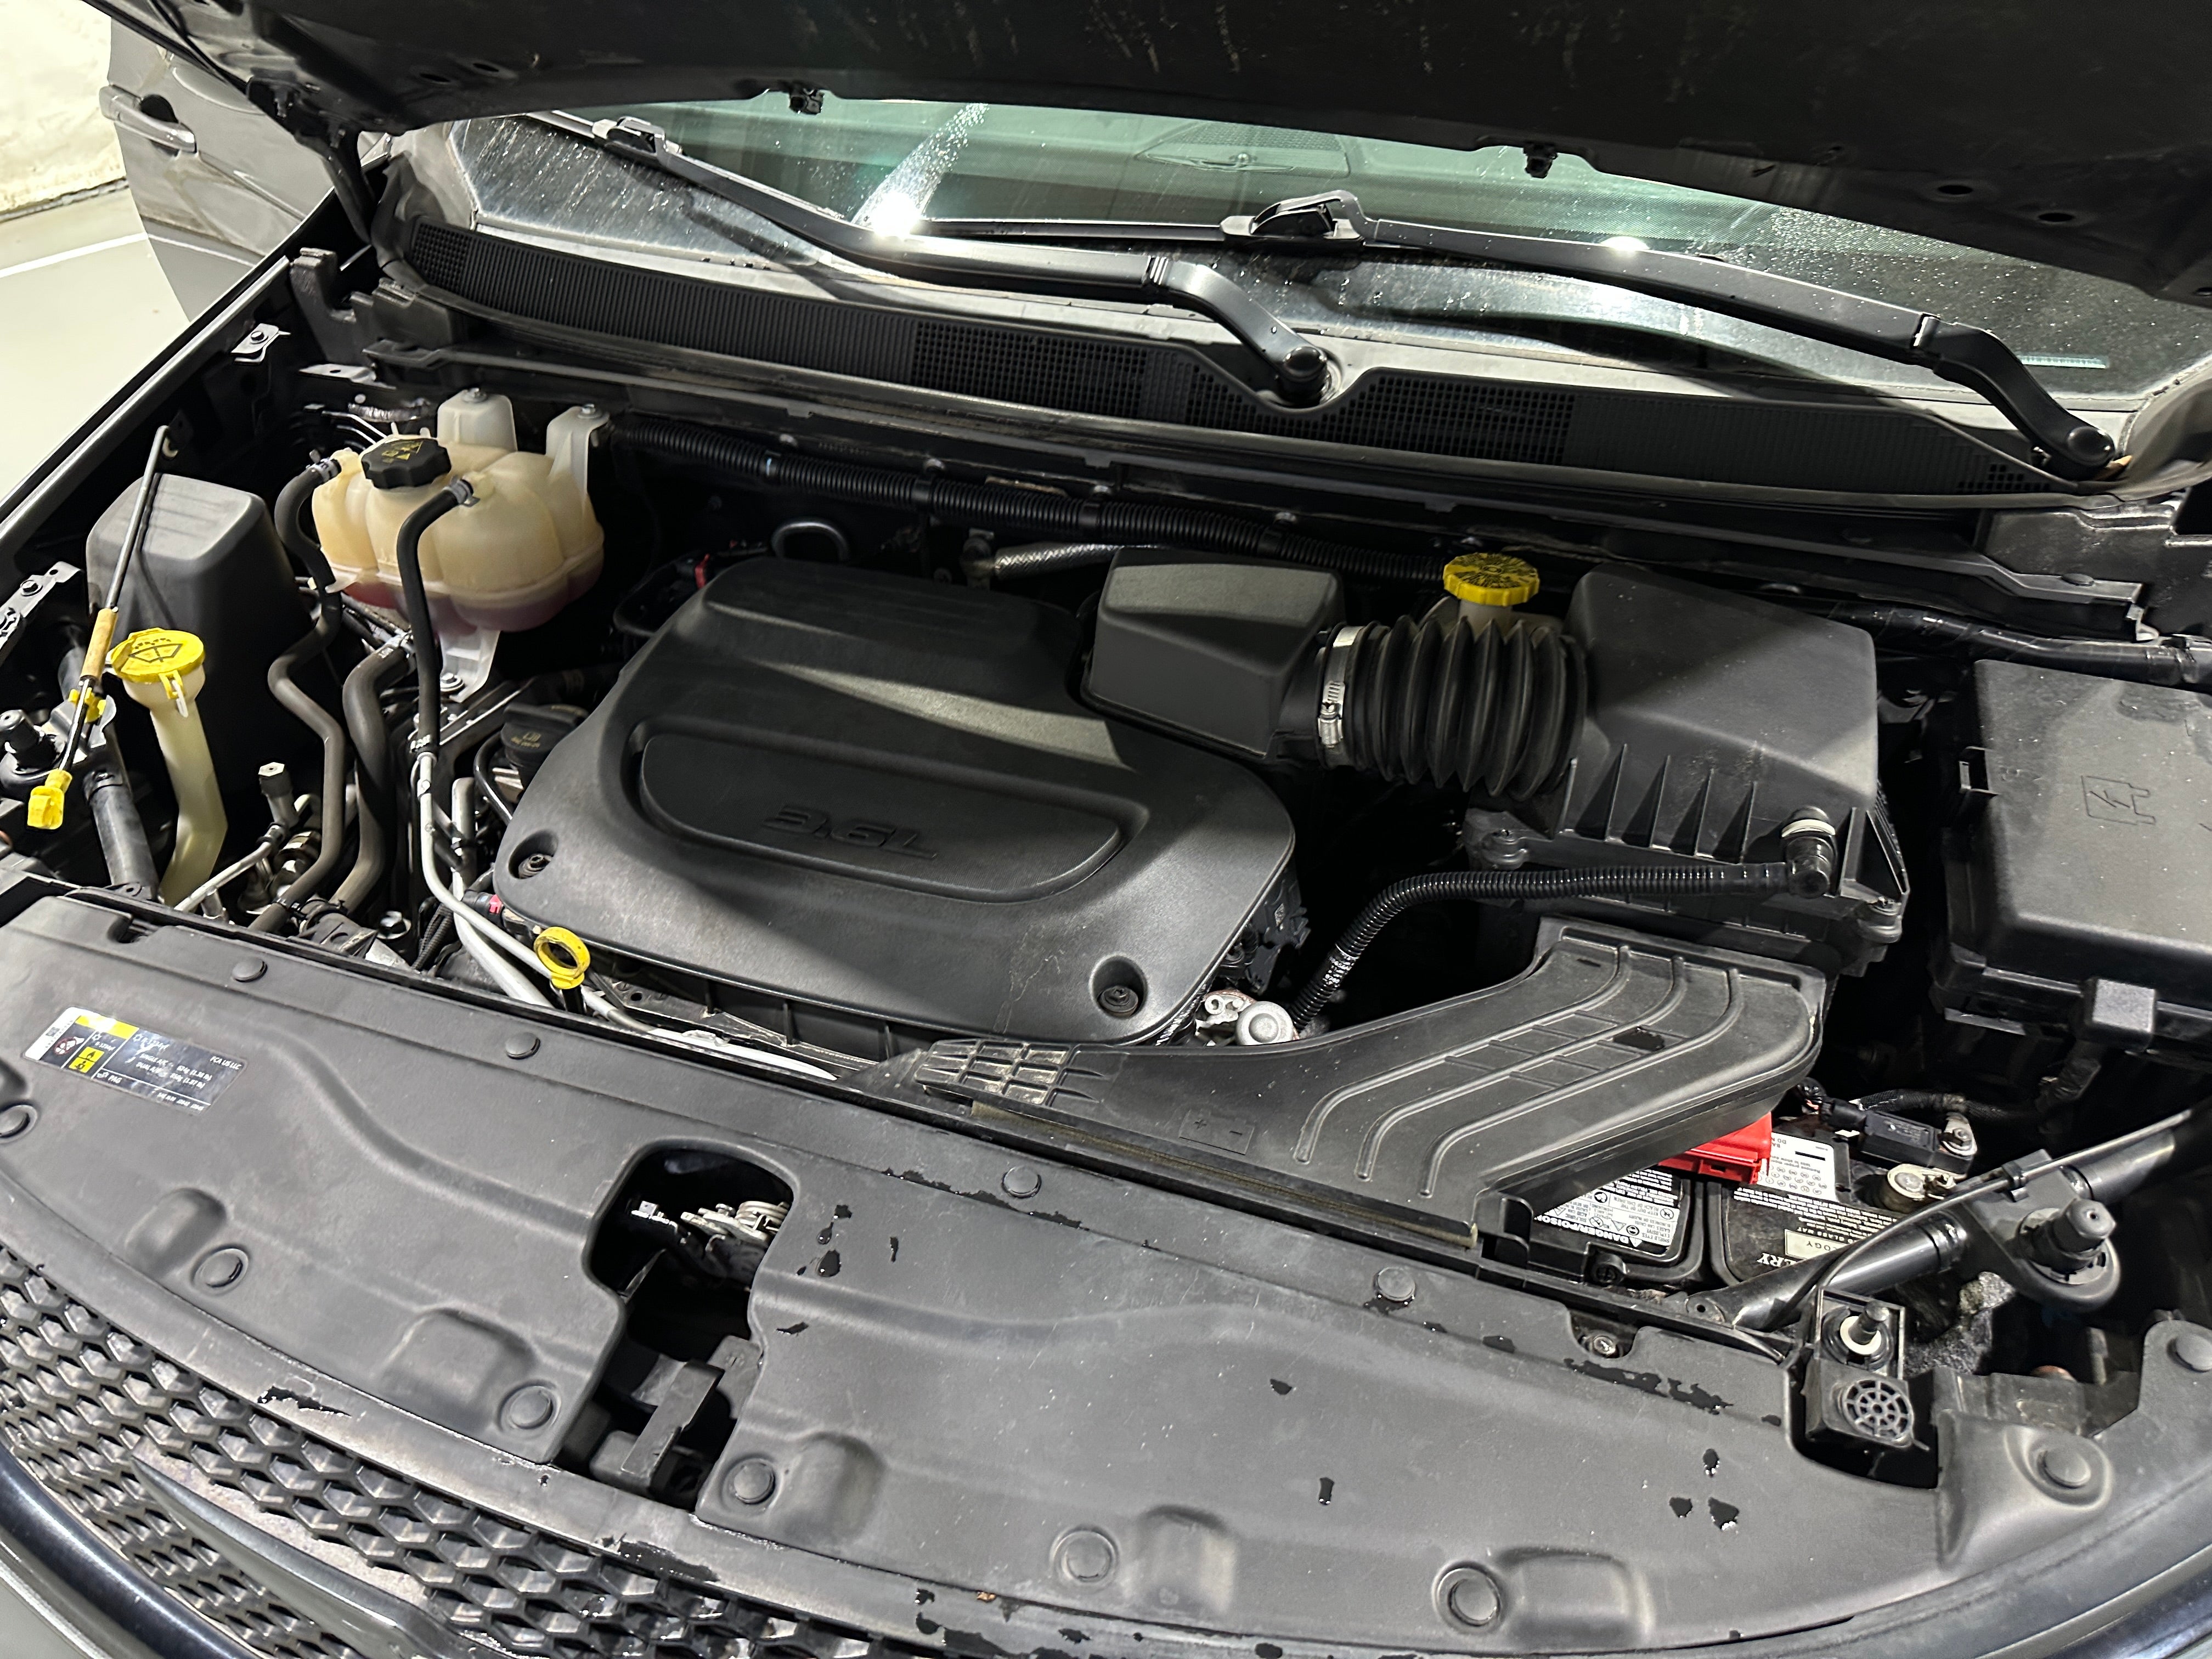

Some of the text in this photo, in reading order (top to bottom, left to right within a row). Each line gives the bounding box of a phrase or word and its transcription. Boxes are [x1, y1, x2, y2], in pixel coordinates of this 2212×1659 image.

[763, 805, 939, 859] 3.6L
[210, 1056, 223, 1064] FCA
[108, 1075, 122, 1084] PAG
[1817, 1231, 1844, 1241] GLASS
[1807, 1241, 1837, 1251] OGY
